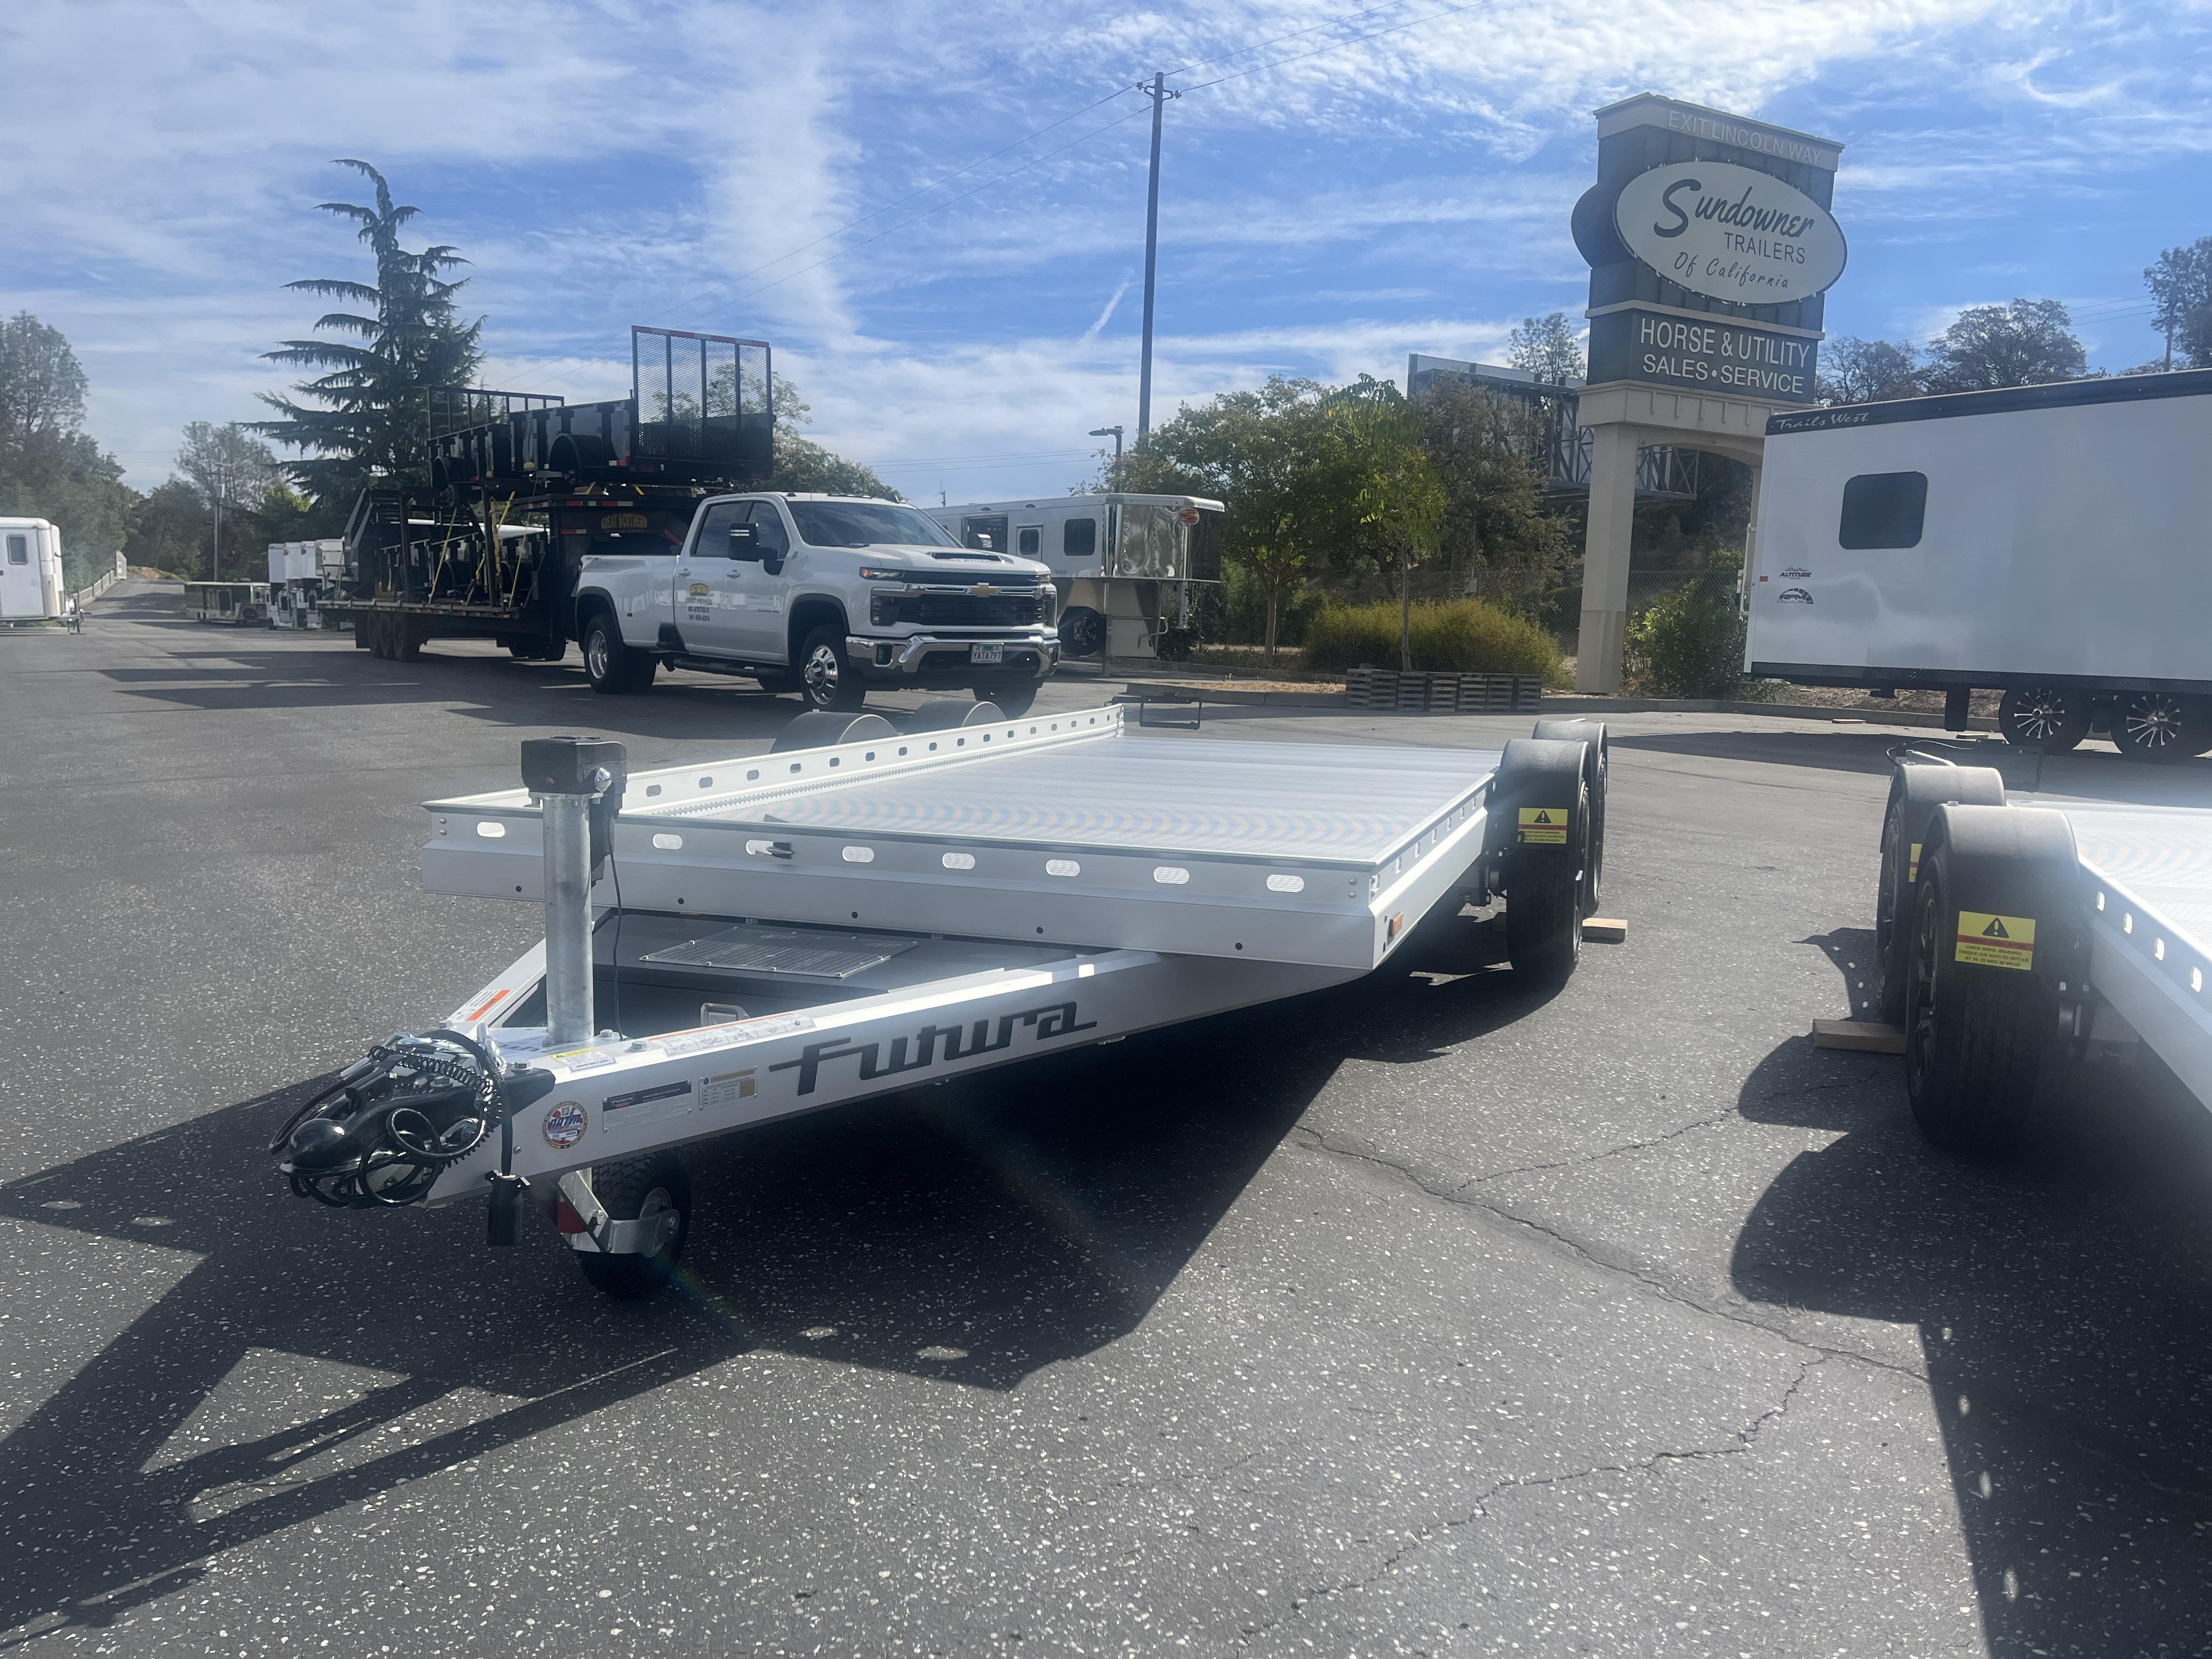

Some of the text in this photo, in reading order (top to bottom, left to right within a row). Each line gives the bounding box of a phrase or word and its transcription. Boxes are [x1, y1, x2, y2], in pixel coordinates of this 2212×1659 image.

[1668, 110, 1821, 163] EXIT LINCOLN WAY
[1653, 178, 1814, 238] Sundowner
[1724, 232, 1805, 264] TRAILERS
[1674, 251, 1788, 289] Of California
[1640, 318, 1809, 369] HORSE & UTILITY
[1775, 412, 1869, 430] Trails West
[601, 514, 617, 529] GREAT
[973, 651, 1001, 660] YATA797
[768, 1000, 1098, 1096] Futura
